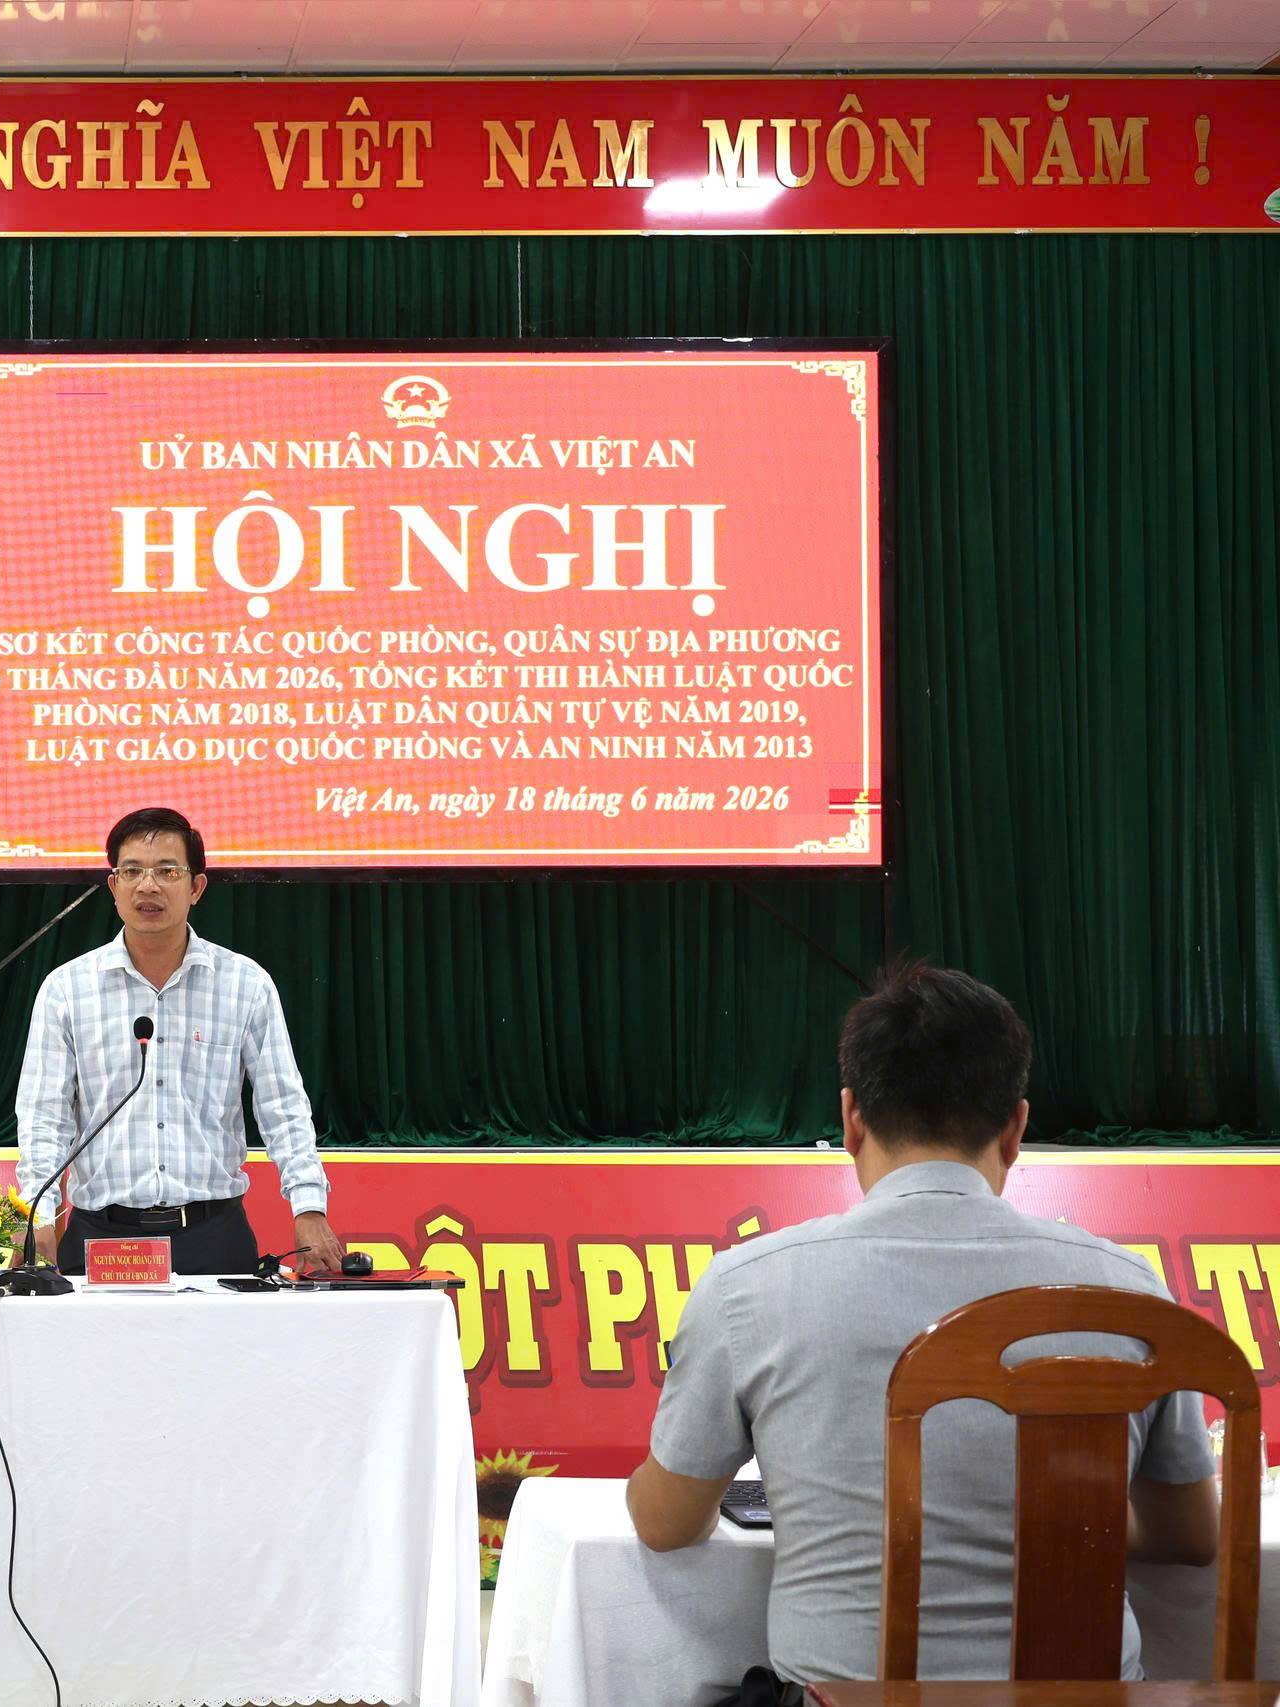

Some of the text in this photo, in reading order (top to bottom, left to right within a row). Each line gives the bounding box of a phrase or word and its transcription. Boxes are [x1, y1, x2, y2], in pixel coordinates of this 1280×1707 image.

[254, 97, 432, 209] VIỆT
[483, 119, 655, 188] NAM
[702, 94, 930, 188] MUÔN
[977, 94, 1150, 186] NĂM
[140, 431, 696, 476] UỶ BAN NHÂN DÂN XÃ VIỆT AN
[111, 490, 727, 619] HỘI NGHỊ
[46, 626, 108, 655] KẾT
[114, 625, 204, 655] CÔNG
[211, 625, 274, 654] TÁC
[281, 624, 371, 658] QUỐC
[378, 624, 497, 656] PHÒNG,
[503, 623, 591, 657] QUÂN
[599, 626, 642, 658] SỰ
[646, 630, 701, 658] ĐỊA
[708, 626, 841, 652] PHƯƠNG
[7, 661, 116, 691] THÁNG
[124, 661, 189, 690] ĐẦU
[197, 661, 268, 689] NĂM
[275, 666, 343, 692] 2026,
[349, 660, 438, 689] TỔNG
[446, 660, 508, 688] KẾT
[514, 665, 569, 688] THI
[577, 659, 666, 688] HÀNH
[674, 661, 757, 693] LUẬT
[763, 658, 853, 692] QUỐC
[32, 694, 807, 730] PHÒNG NĂM 2018, LUẬT DÂN QUÂN TỰ VỆ NĂM 2019,
[26, 730, 813, 767] LUẬT GIÁO DỤC QUỐC PHÒNG VÀ AN NINH NĂM 2013
[315, 785, 789, 817] Việt An, ngày 18 tháng 6 năm 2026
